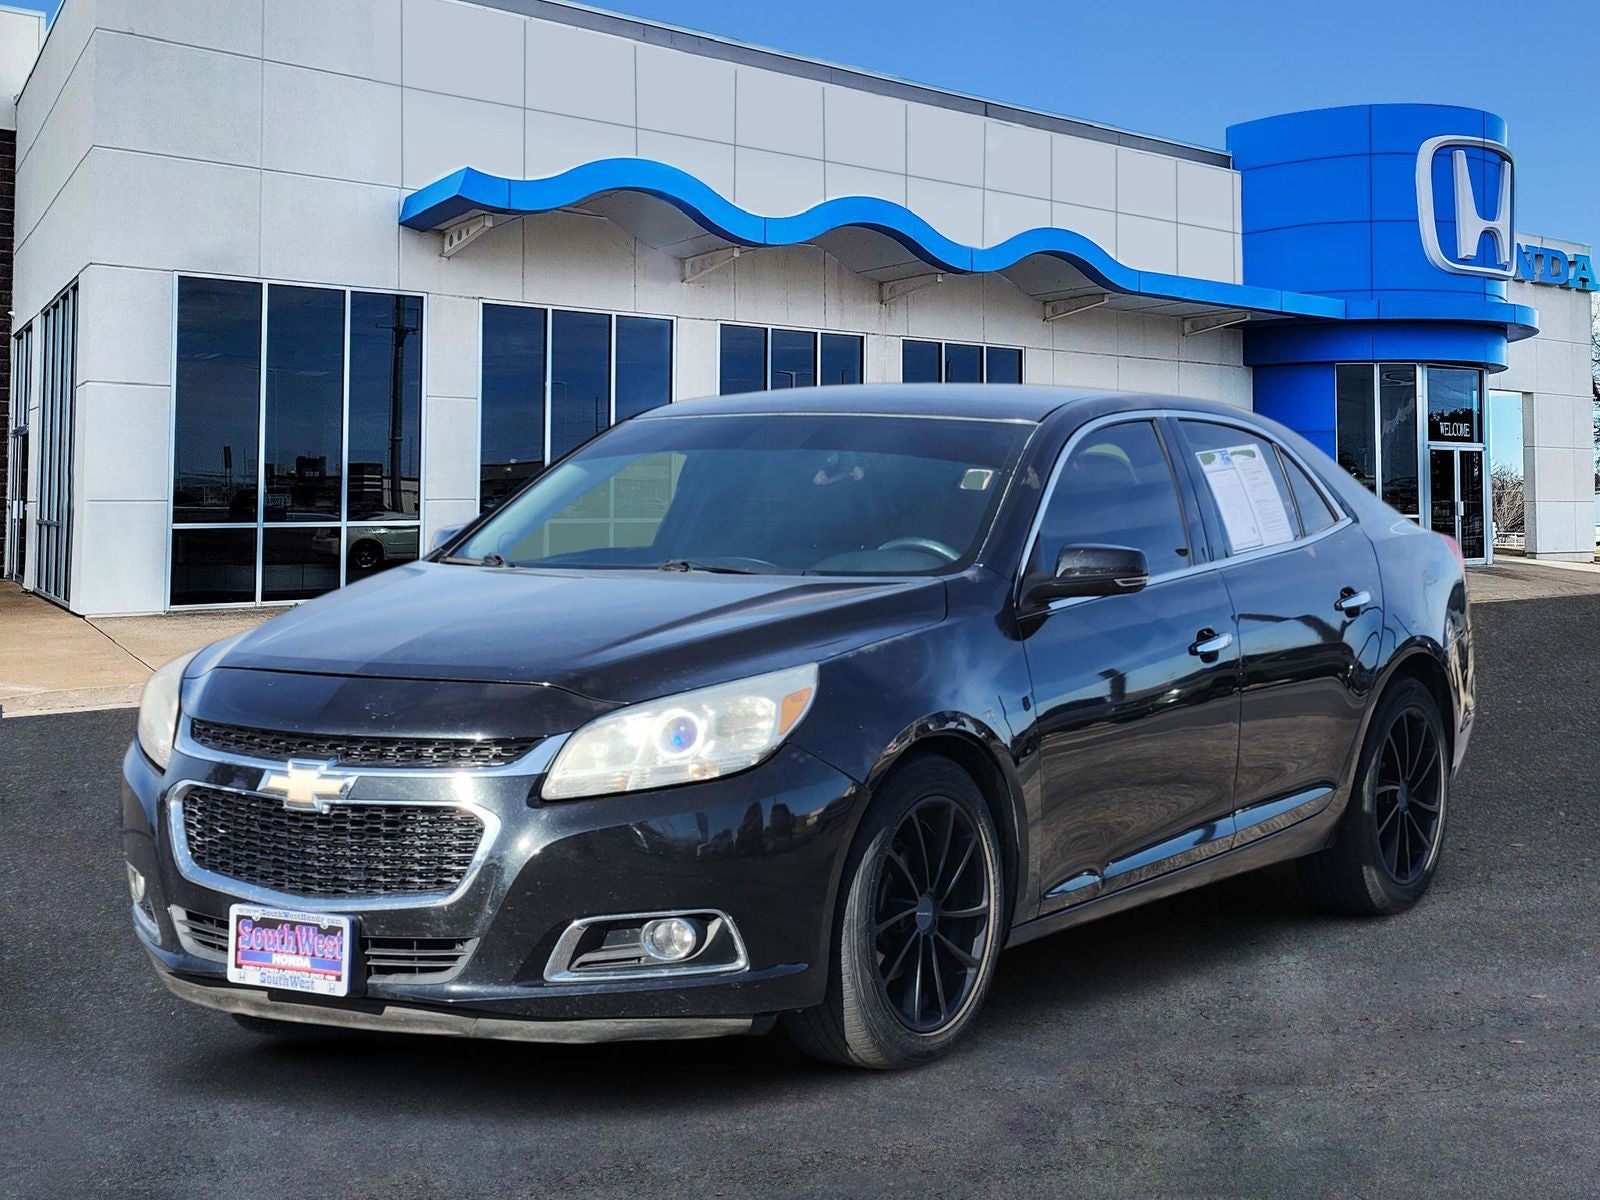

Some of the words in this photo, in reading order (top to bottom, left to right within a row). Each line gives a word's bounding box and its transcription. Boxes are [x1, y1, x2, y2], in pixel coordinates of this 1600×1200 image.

[1439, 422, 1471, 437] WELCOME
[238, 918, 343, 959] SouthWest
[259, 969, 315, 991] SouthWest
